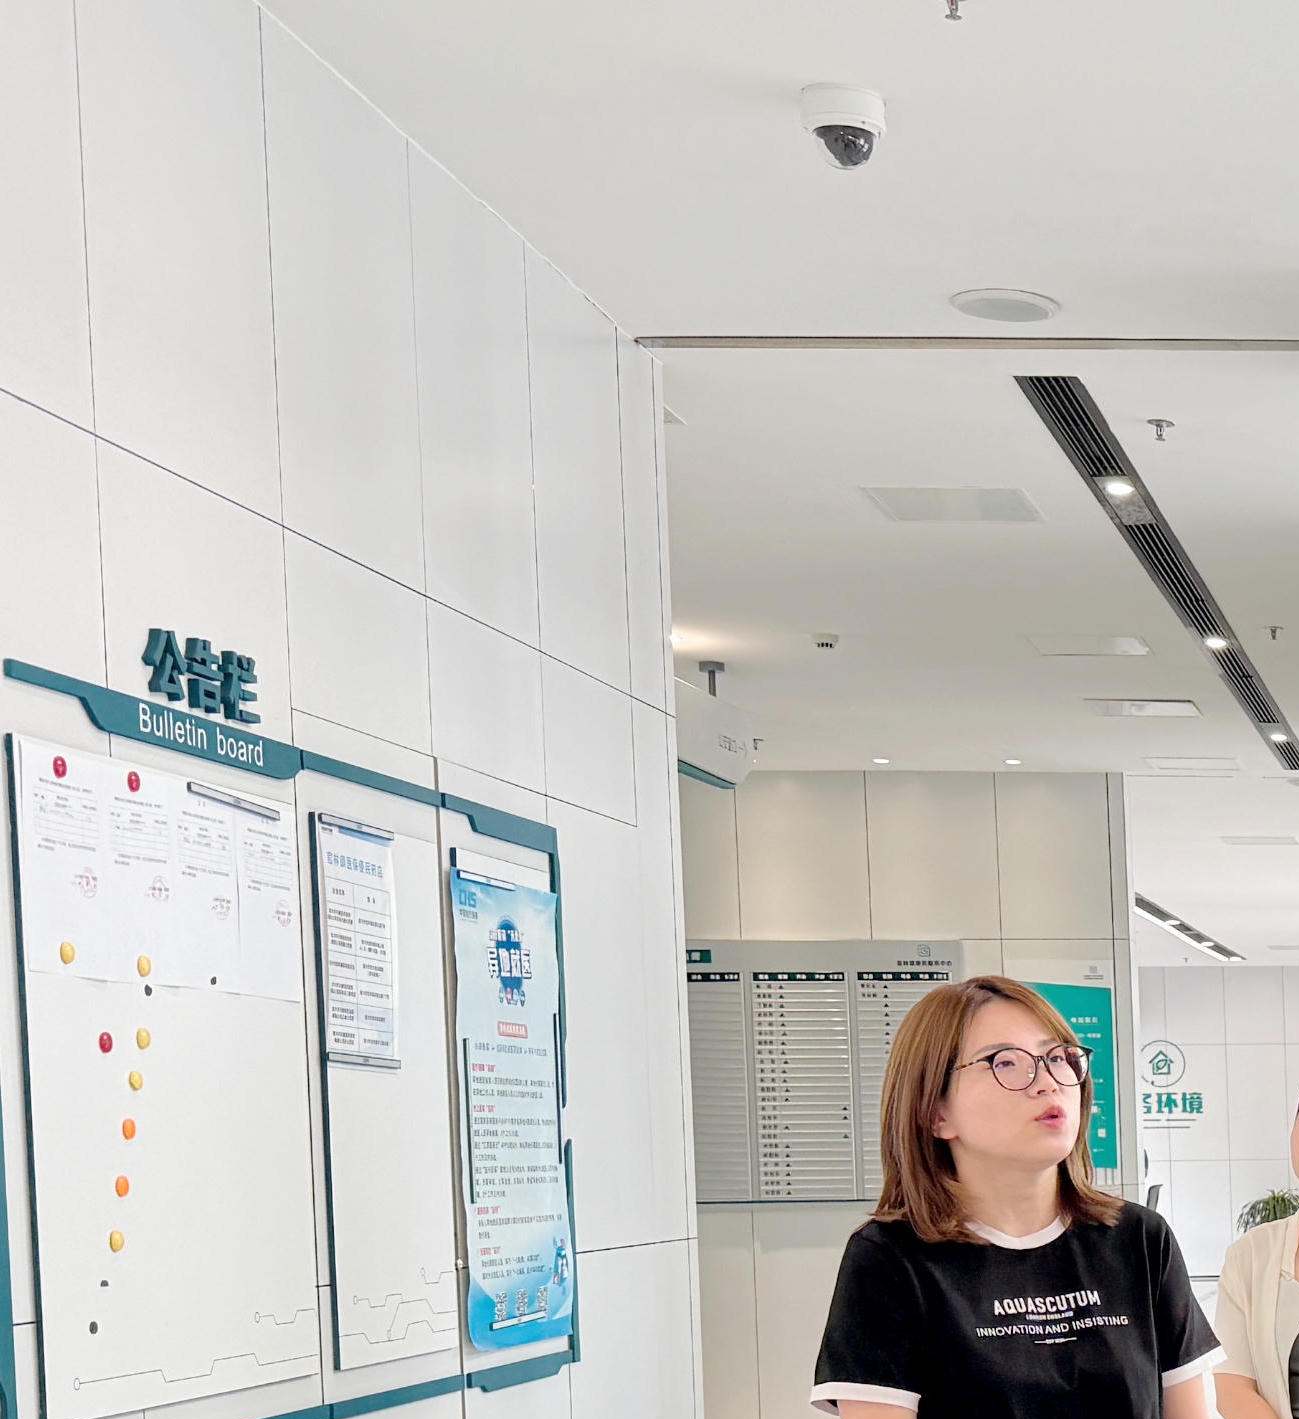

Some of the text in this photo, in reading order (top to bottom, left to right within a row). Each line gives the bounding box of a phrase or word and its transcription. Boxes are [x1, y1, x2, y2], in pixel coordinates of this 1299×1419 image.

[141, 628, 261, 724] 公告栏
[138, 702, 264, 767] Bulletin board
[993, 1289, 1102, 1316] AQUASCUTUM
[976, 1324, 1044, 1338] INNOVATION
[1045, 1322, 1070, 1335] AND
